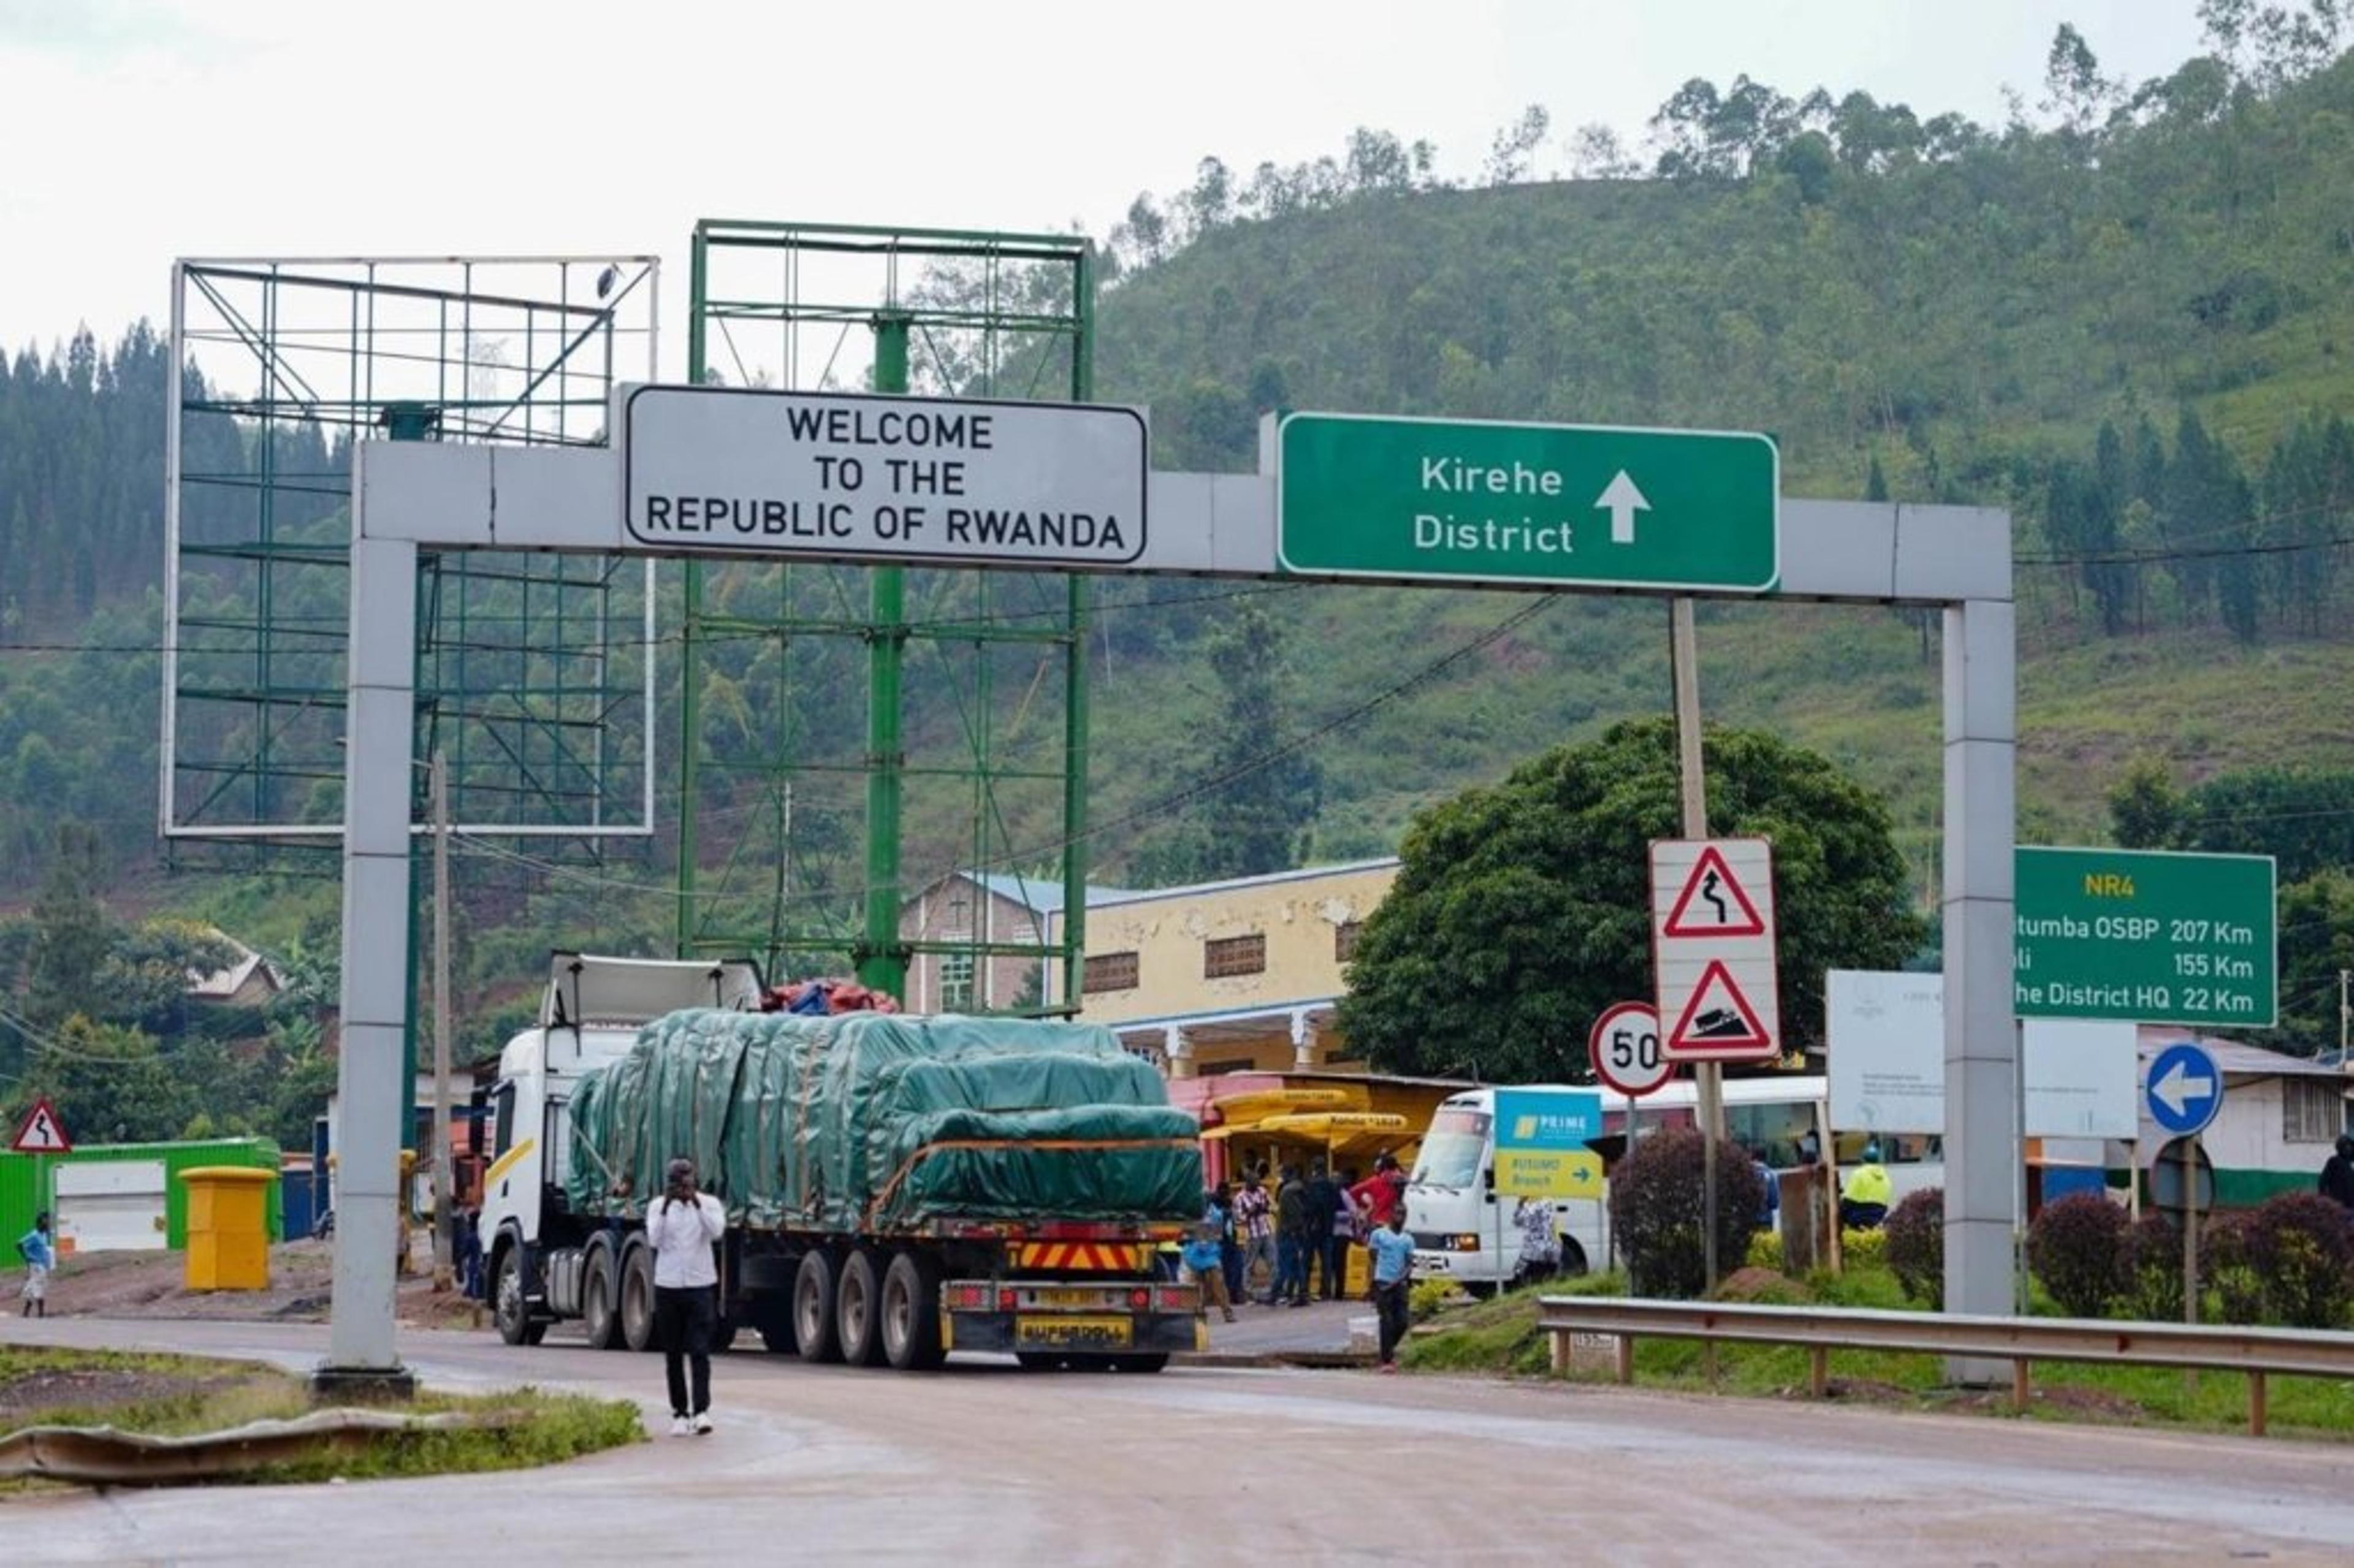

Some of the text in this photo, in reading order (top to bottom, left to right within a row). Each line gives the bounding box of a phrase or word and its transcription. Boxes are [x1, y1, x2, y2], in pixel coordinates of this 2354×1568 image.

[787, 408, 992, 450] WELCOME
[814, 455, 965, 496] TO THE
[1422, 457, 1562, 495] Kirehe
[647, 496, 1125, 549] REPUBLIC OF RWANDA
[1415, 514, 1573, 553] District
[2084, 875, 2134, 896] NR4
[2017, 915, 2253, 944] tumba OSBP 207 Km
[2174, 953, 2209, 976] 155
[2215, 955, 2253, 978] Km
[2049, 982, 2130, 1007] District
[2137, 986, 2171, 1010] HQ
[2183, 987, 2209, 1011] 22
[2215, 989, 2253, 1012] Km
[1612, 1031, 1659, 1070] 50
[1540, 1114, 1586, 1128] PRIME
